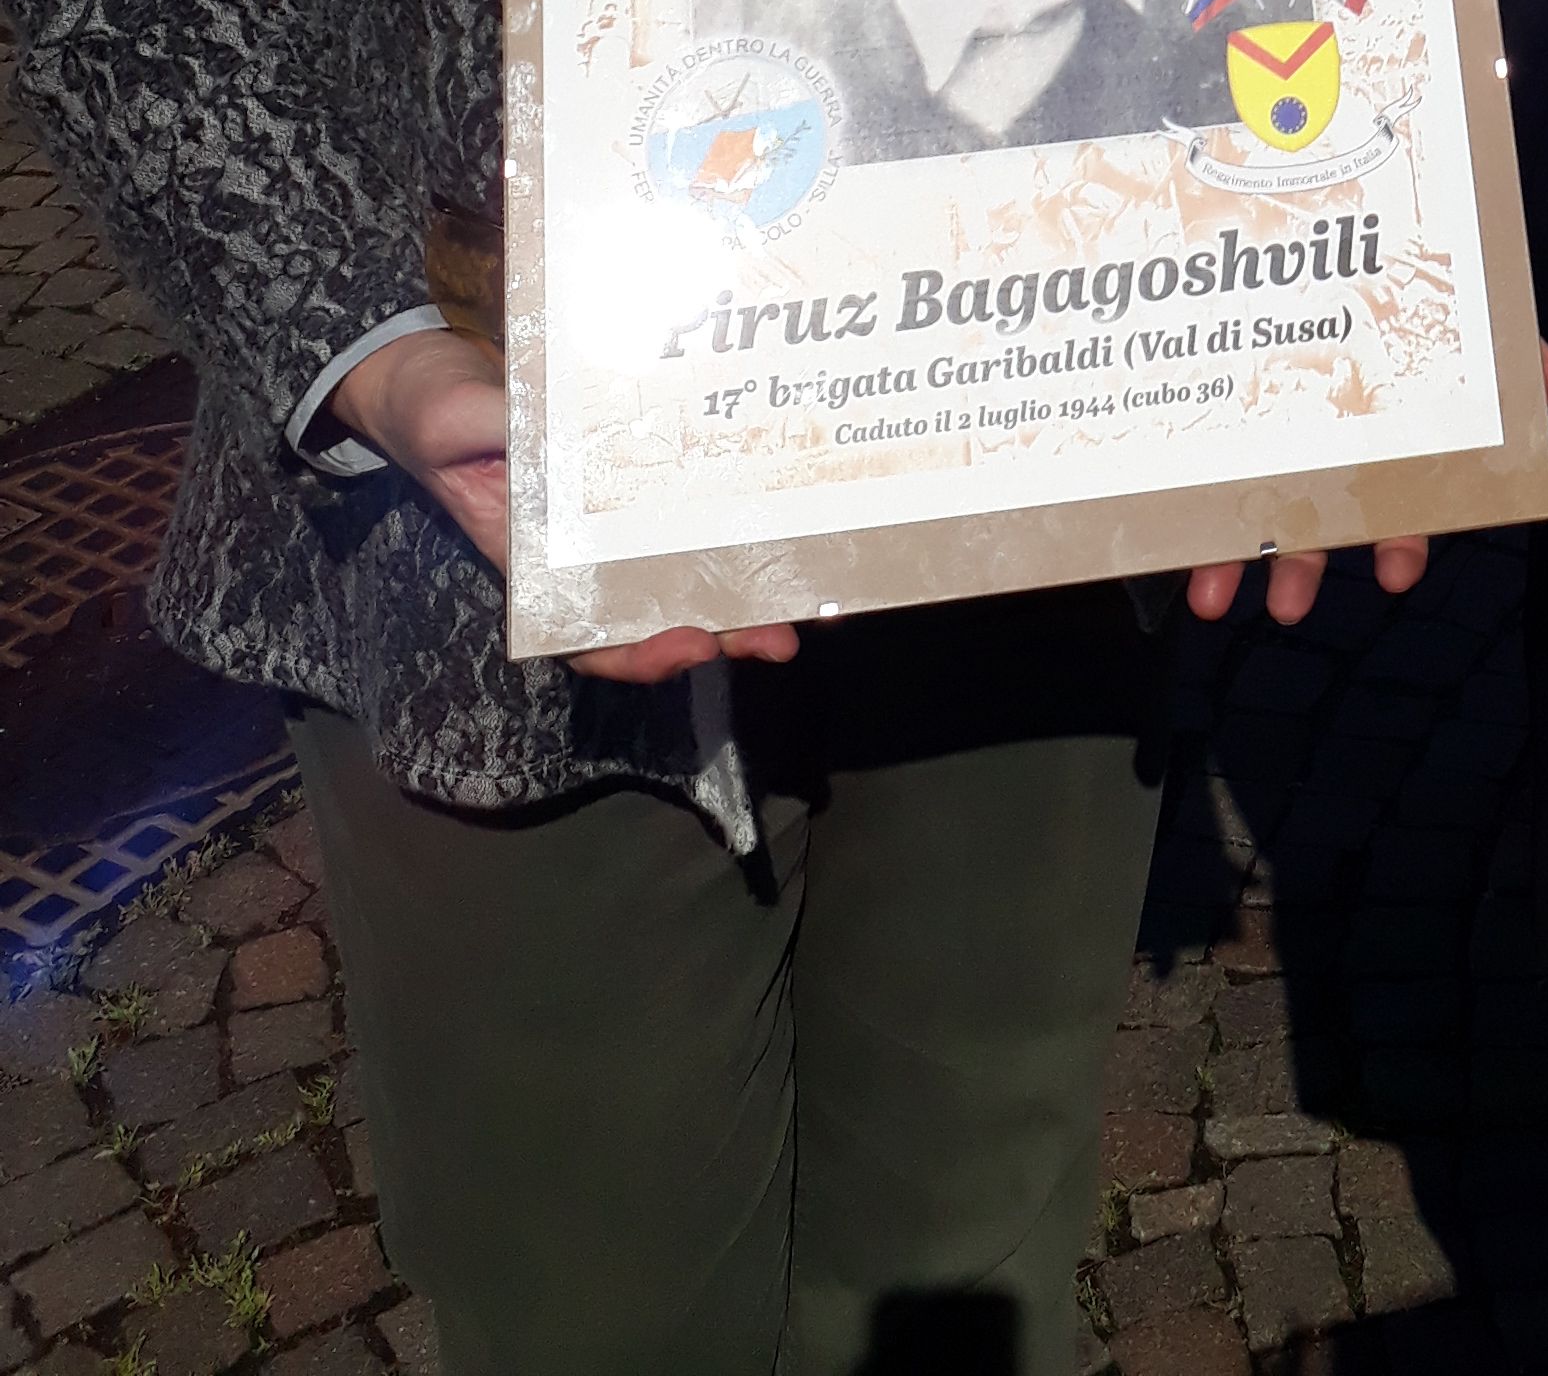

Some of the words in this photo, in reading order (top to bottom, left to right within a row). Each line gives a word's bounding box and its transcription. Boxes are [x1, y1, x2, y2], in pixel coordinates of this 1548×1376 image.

[682, 38, 764, 70] DENTRO
[769, 41, 790, 64] LA
[794, 56, 842, 128] GUERRA
[1202, 162, 1273, 188] Reggimento
[1277, 169, 1337, 188] Immortale
[1340, 162, 1353, 176] in
[1353, 146, 1383, 169] Italia
[895, 213, 1384, 336] Bagagoshvili
[769, 365, 918, 410] brigata
[927, 336, 1114, 389] Garibaldi
[1123, 324, 1198, 371] (Val
[1206, 319, 1243, 355] di
[1251, 304, 1353, 350] Susa)
[835, 416, 928, 445] Caduto
[934, 410, 952, 434] il
[957, 413, 971, 431] 2
[978, 401, 1051, 431] luglio
[1058, 395, 1117, 421] 1944
[1122, 382, 1191, 412] (cubo
[1197, 374, 1235, 405] 36)
